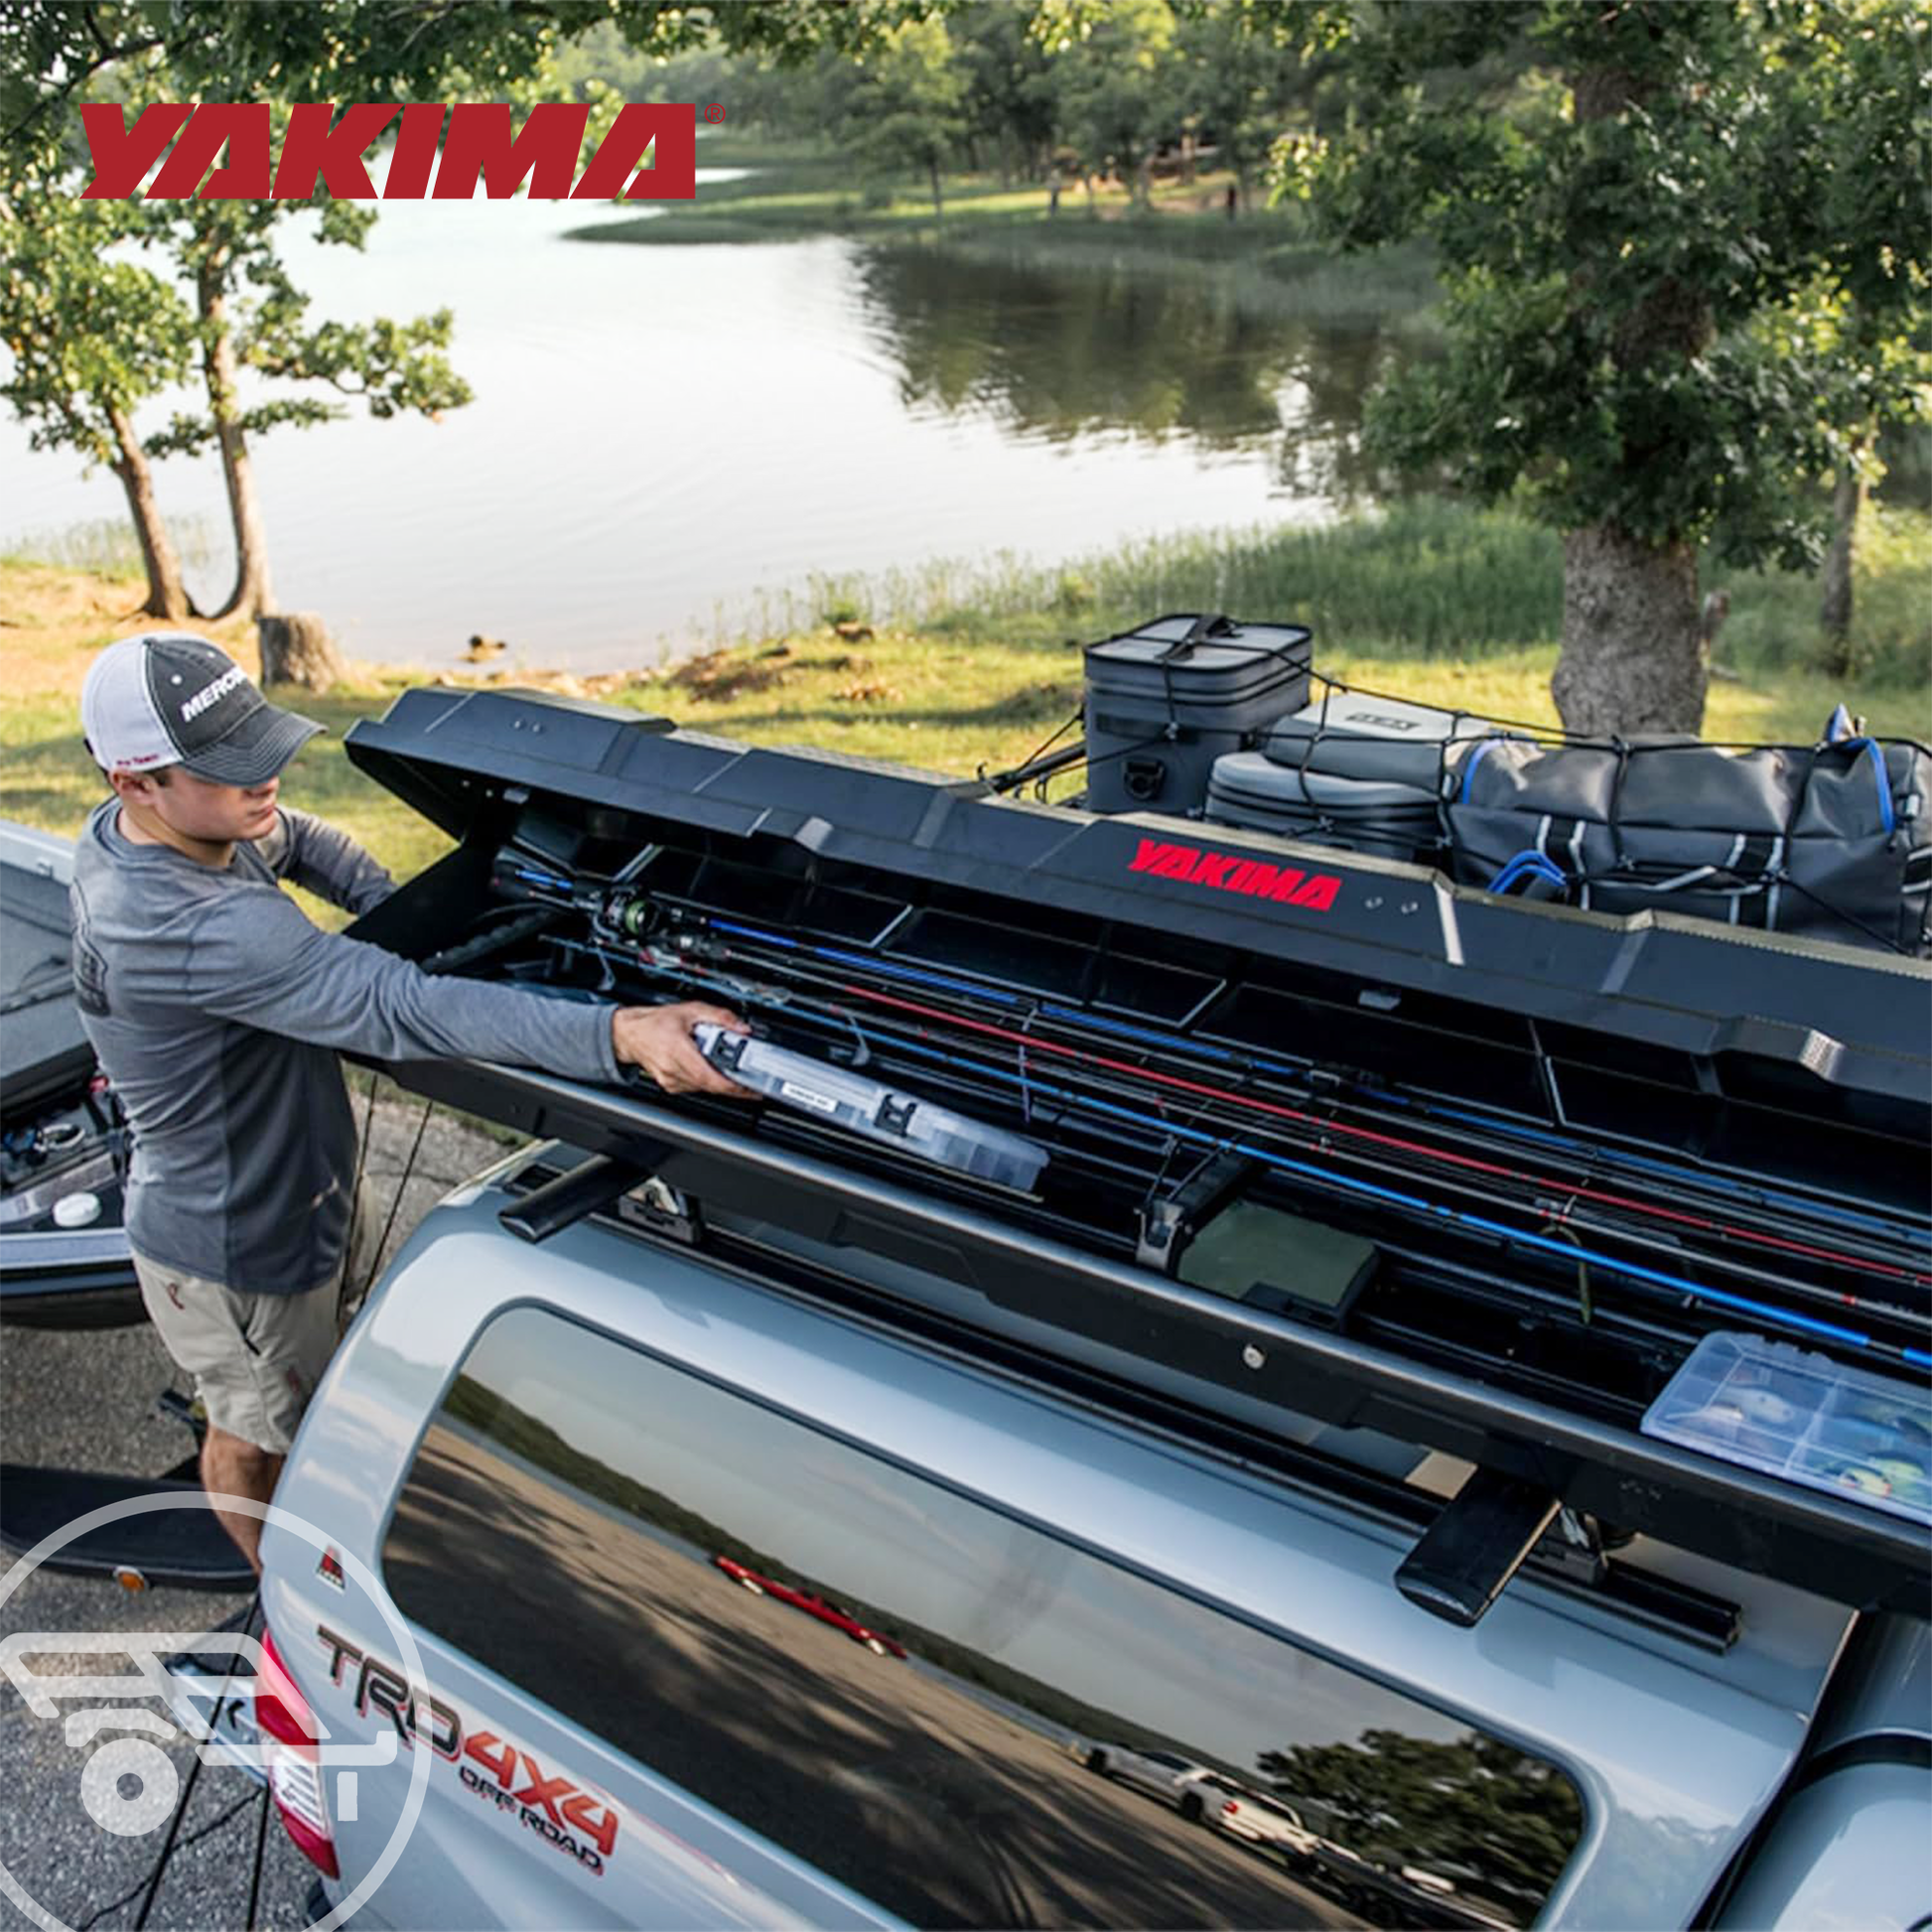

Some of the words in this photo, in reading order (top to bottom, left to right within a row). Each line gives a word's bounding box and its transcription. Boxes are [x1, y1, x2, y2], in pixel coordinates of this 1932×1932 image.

[1128, 839, 1342, 912] YAKIMA
[318, 1624, 465, 1762] TRD
[519, 1806, 605, 1875] ROAD
